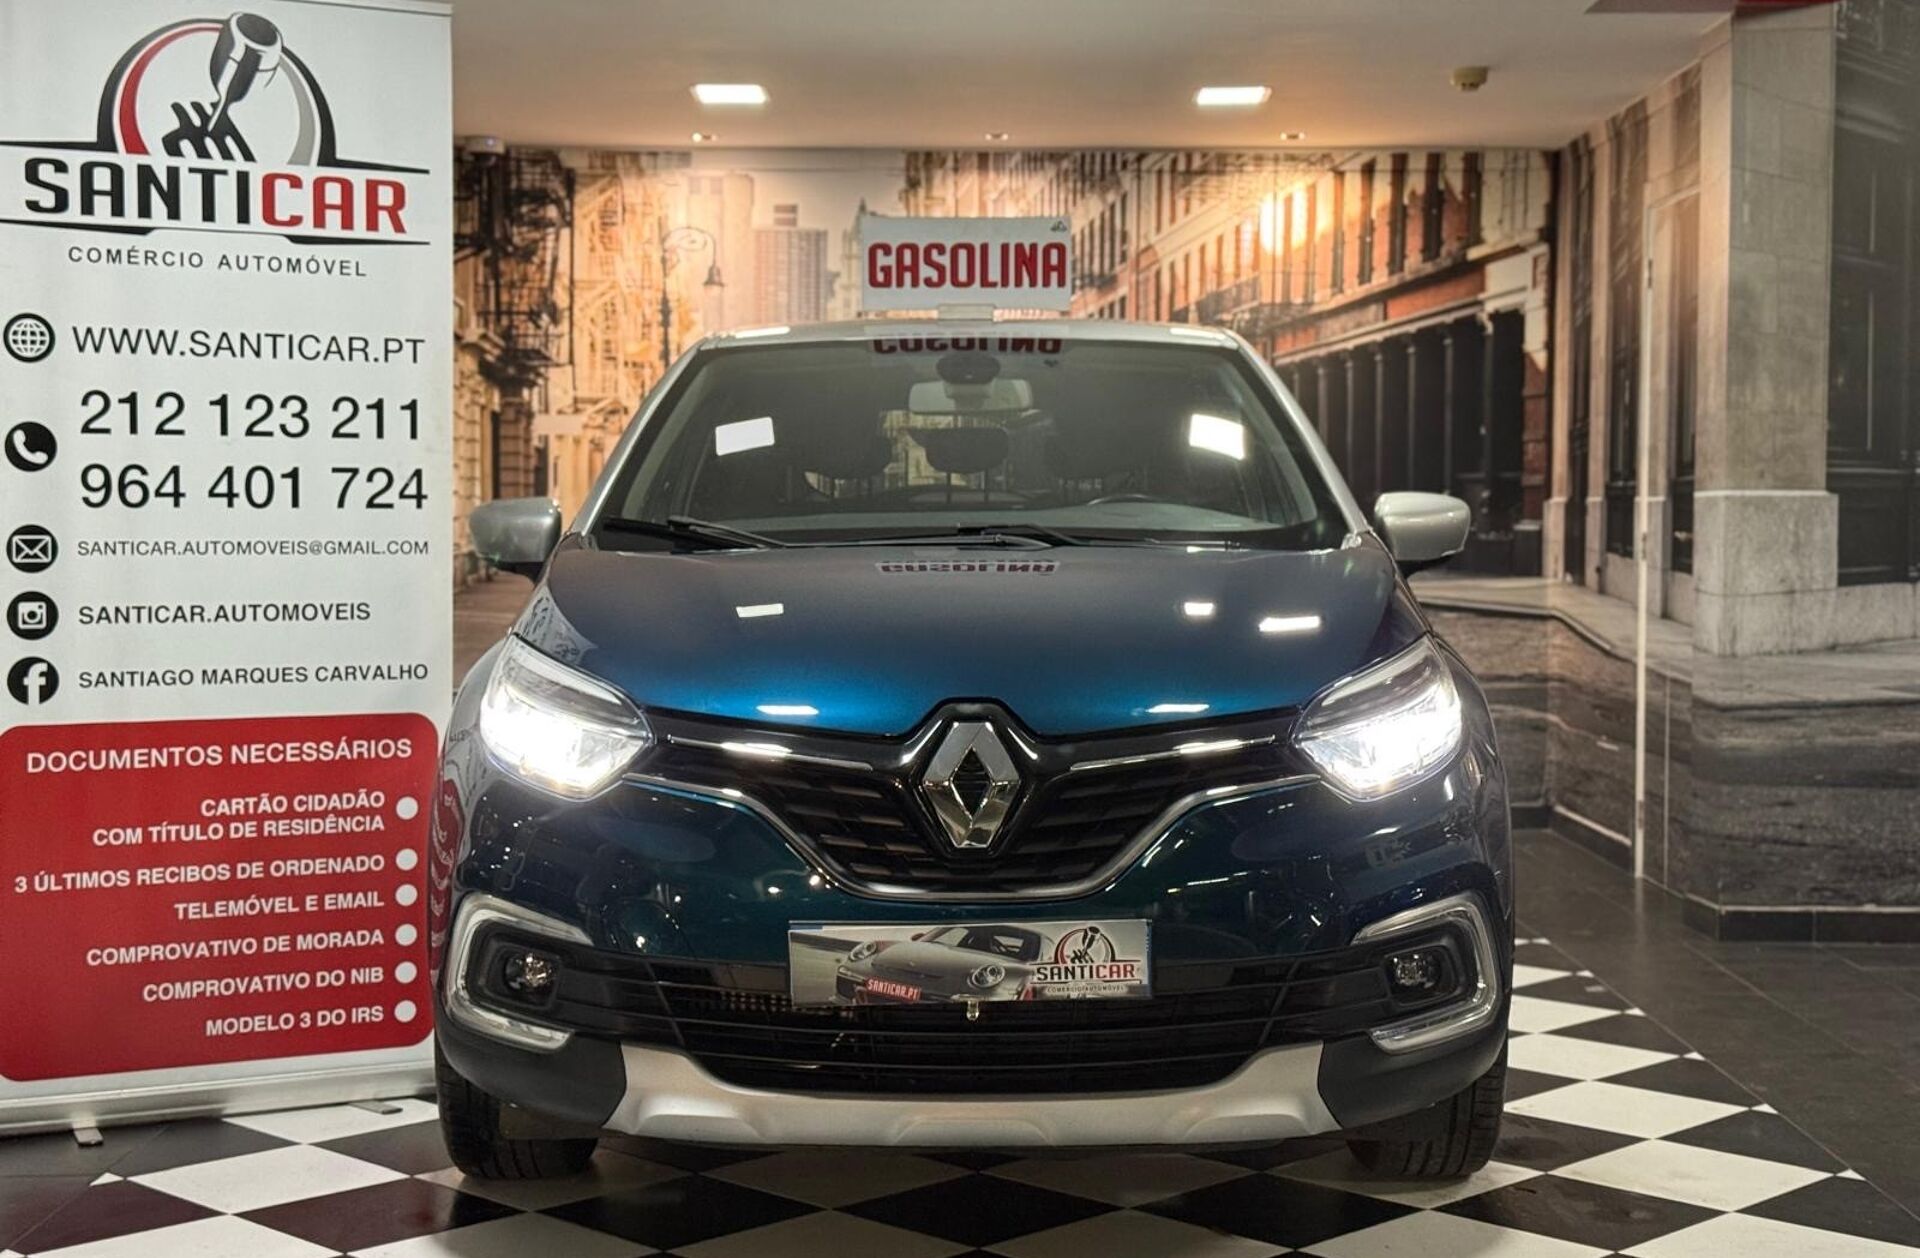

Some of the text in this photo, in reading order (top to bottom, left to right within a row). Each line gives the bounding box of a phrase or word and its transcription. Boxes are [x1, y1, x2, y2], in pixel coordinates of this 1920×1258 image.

[24, 157, 407, 235] SANTICAR
[68, 245, 367, 277] COMÉRCIO AUTOMÓVEL
[868, 242, 1067, 288] GASOLINA
[72, 326, 426, 364] WWW.SANTICAR.PT
[80, 389, 419, 440] 212 123 211
[80, 463, 428, 510] 964 401 724
[77, 540, 429, 557] SANTICAR.AUTOMOVEIS@GMAIL.COM
[78, 602, 371, 625] SANTICAR.AUTOMOVEIS
[79, 663, 429, 689] SANTIAGO MARQUES CARVALHO
[27, 736, 412, 773] DOCUMENTOS NECESSÁRIOS
[200, 788, 385, 818] CARTÃO CIDADÃO
[92, 813, 385, 846] COM TÍTULO DE RESIDÊNCIA
[14, 854, 385, 893] 3 ÚLTIMOS RECIBOS DE ORDENADO
[174, 891, 385, 920] TELEMÓVEL E EMAIL
[86, 929, 385, 966] COMPROVATIVO DE MORADA
[143, 966, 384, 1002] COMPROVATIVO DO NIB
[1036, 963, 1135, 981] SANTICAR
[205, 1005, 384, 1036] MODELO 3 DO IRS
